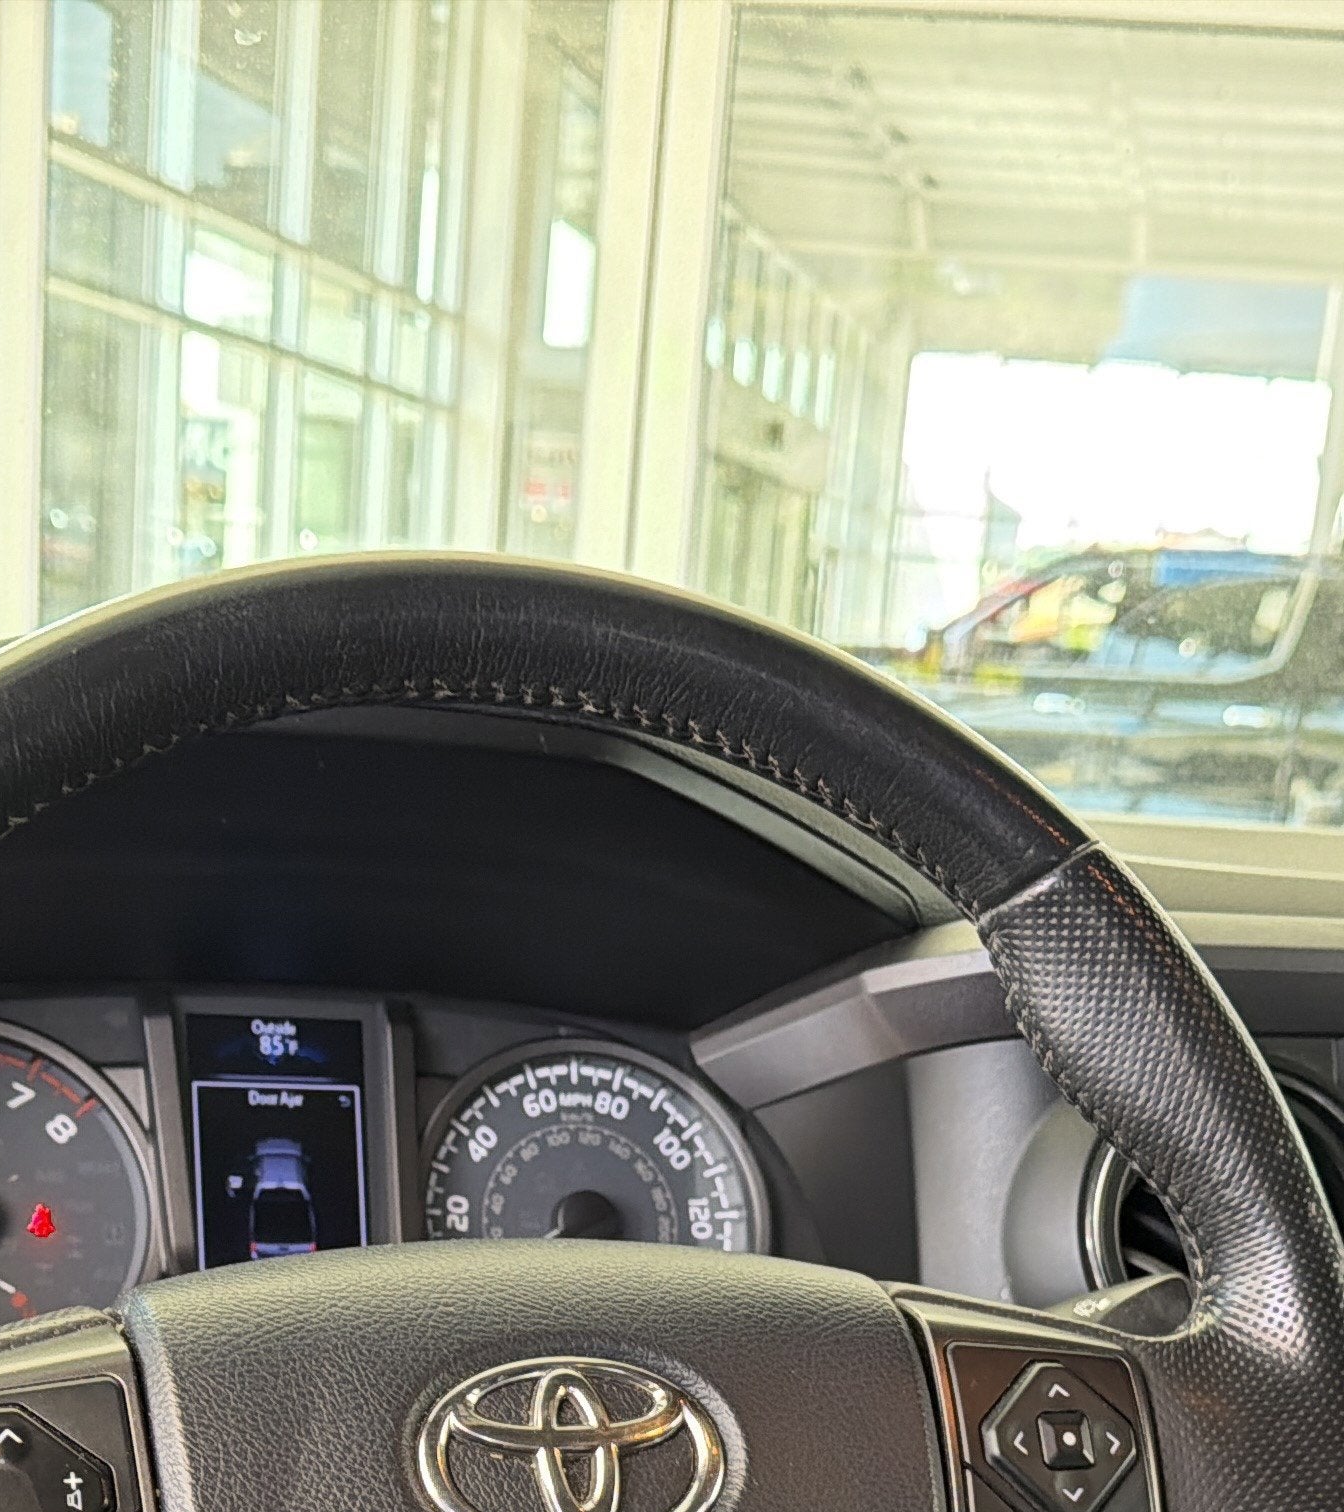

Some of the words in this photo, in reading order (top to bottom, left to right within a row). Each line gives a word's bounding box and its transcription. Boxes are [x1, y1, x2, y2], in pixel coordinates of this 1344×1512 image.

[6, 1081, 36, 1109] 7
[522, 1089, 557, 1117] 60
[594, 1091, 630, 1120] 80
[45, 1114, 77, 1144] 8
[468, 1125, 498, 1162] 40
[653, 1127, 692, 1170] 100
[446, 1195, 469, 1232] 20
[687, 1197, 713, 1240] 120
